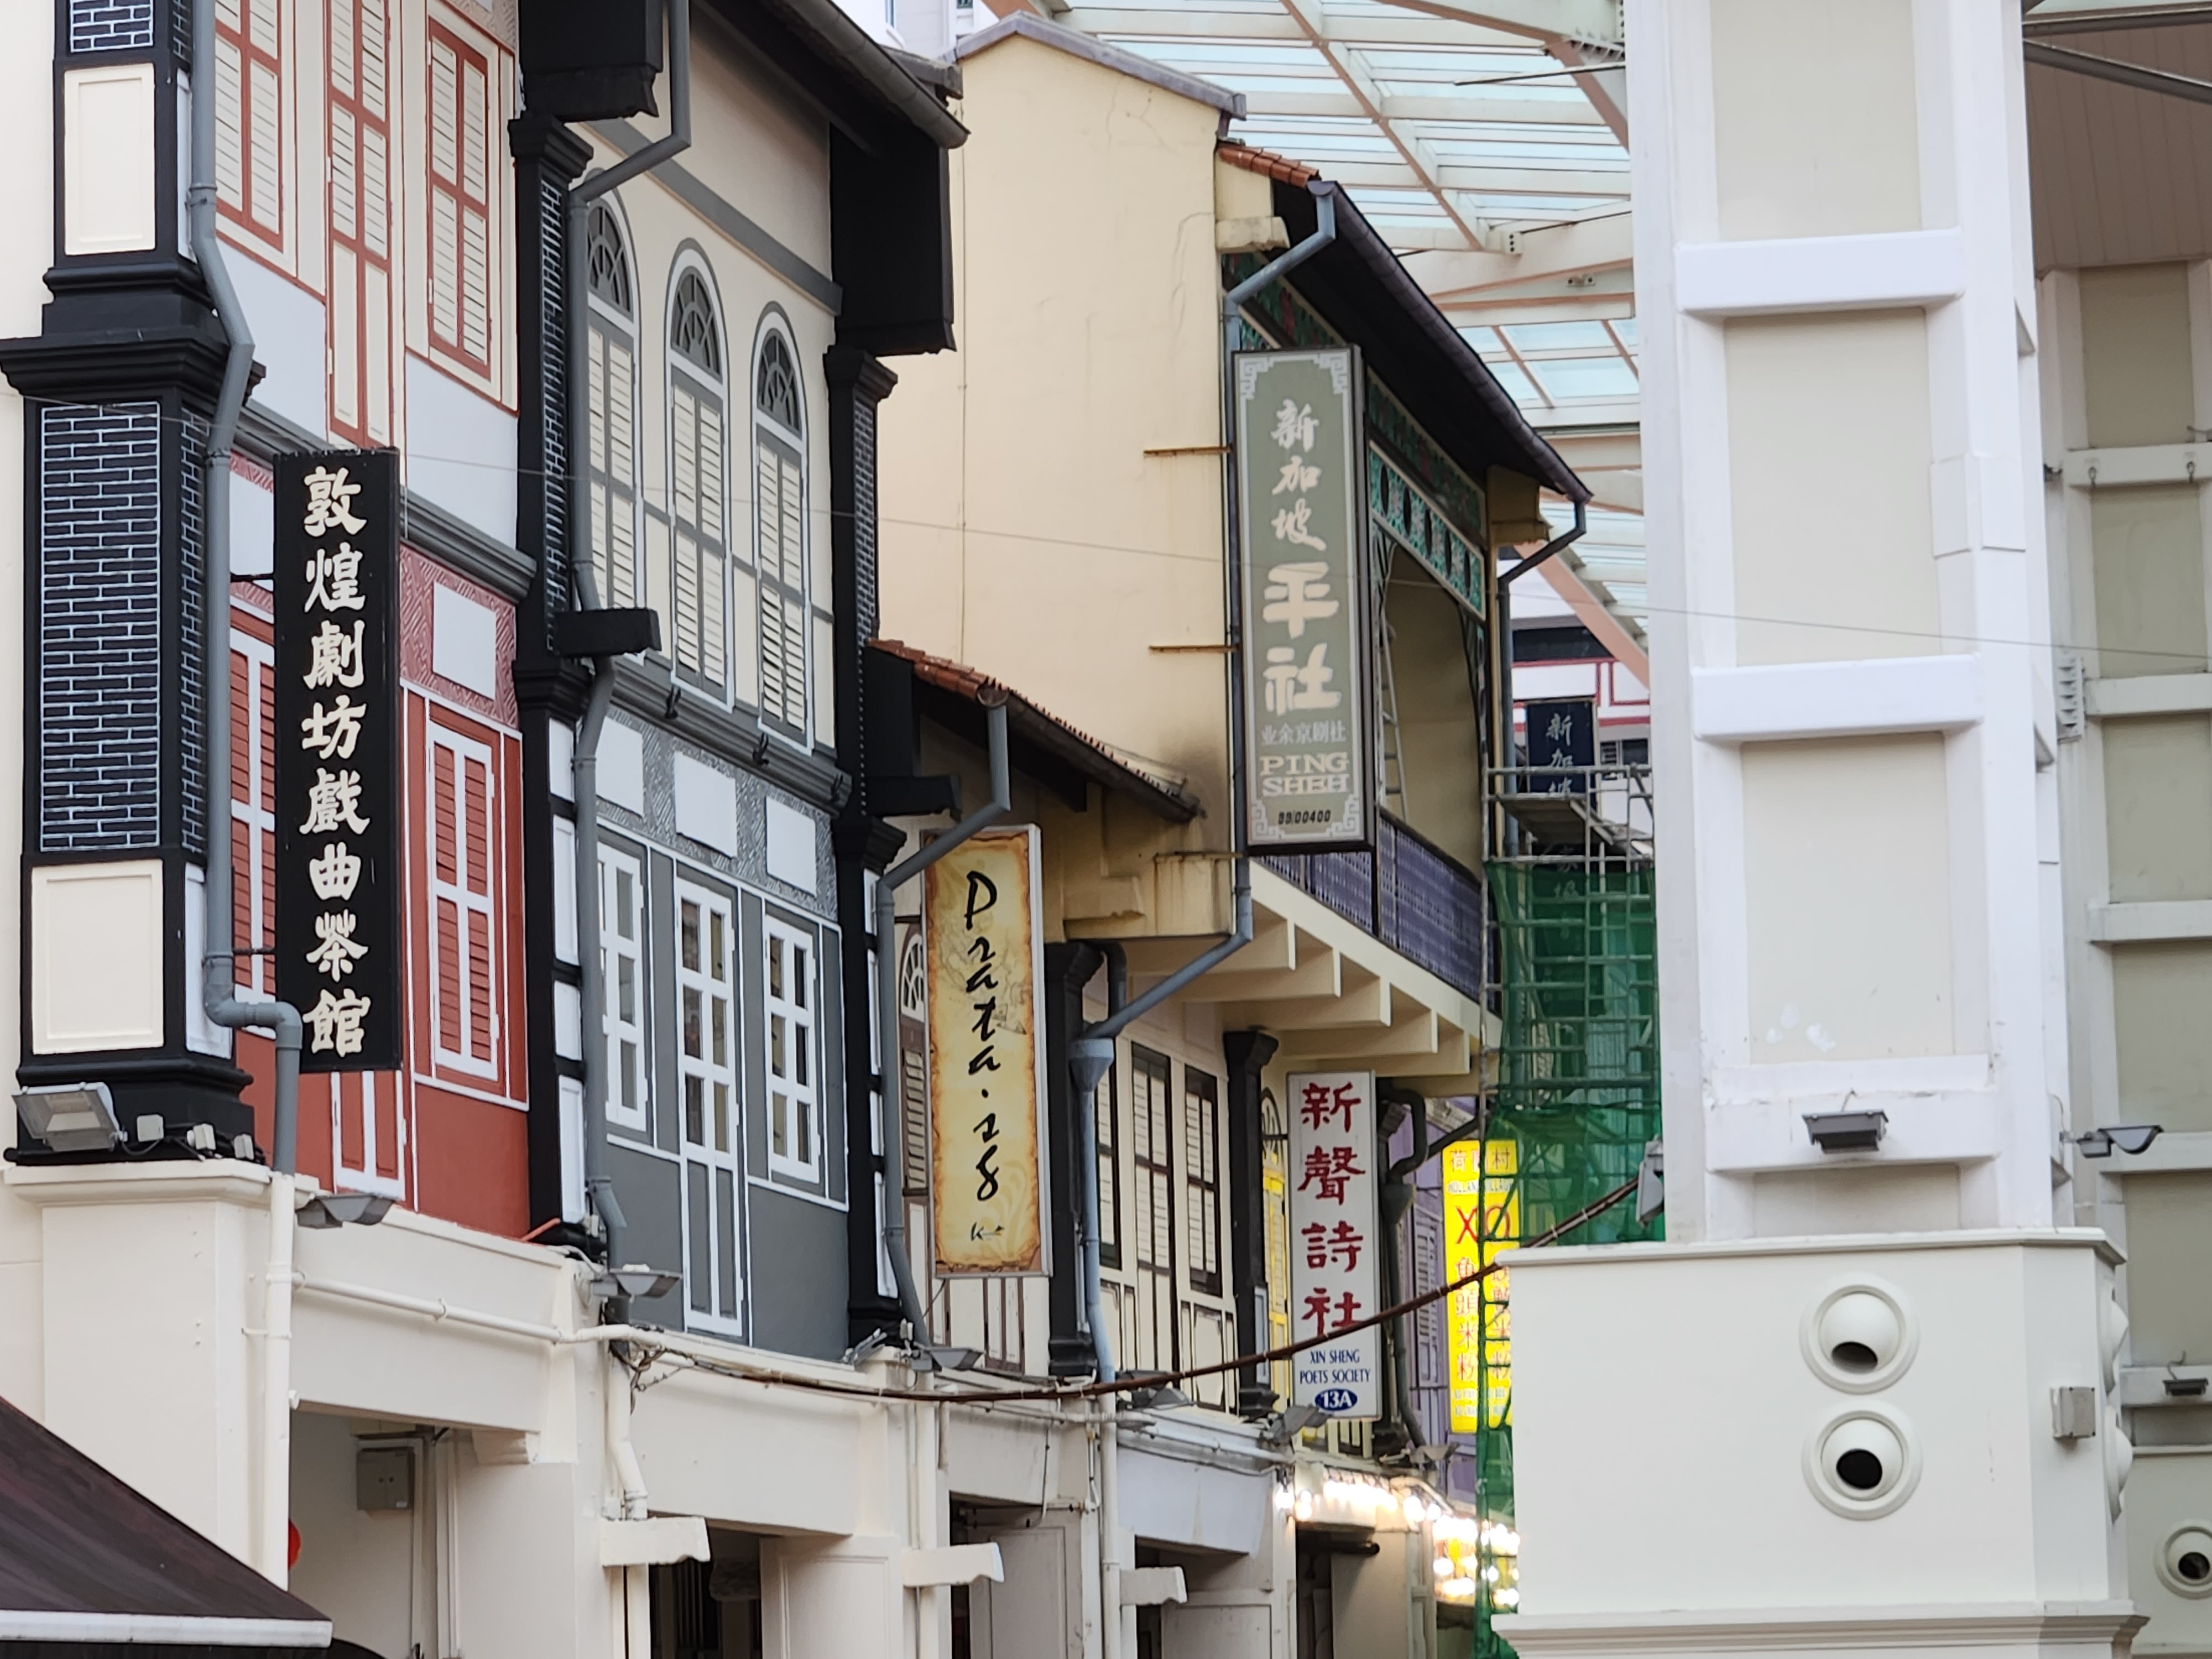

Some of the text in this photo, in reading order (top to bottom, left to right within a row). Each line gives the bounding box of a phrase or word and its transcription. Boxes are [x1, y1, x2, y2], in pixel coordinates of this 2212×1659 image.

[1259, 752, 1349, 776] PING
[1262, 774, 1350, 796] SHEH
[1297, 1082, 1365, 1335] 新聲詩社
[1455, 1206, 1510, 1244] XO
[1310, 1349, 1360, 1364] XIN SHENG
[1300, 1368, 1371, 1385] POETS SOCIETY
[1321, 1390, 1353, 1408] 13A
